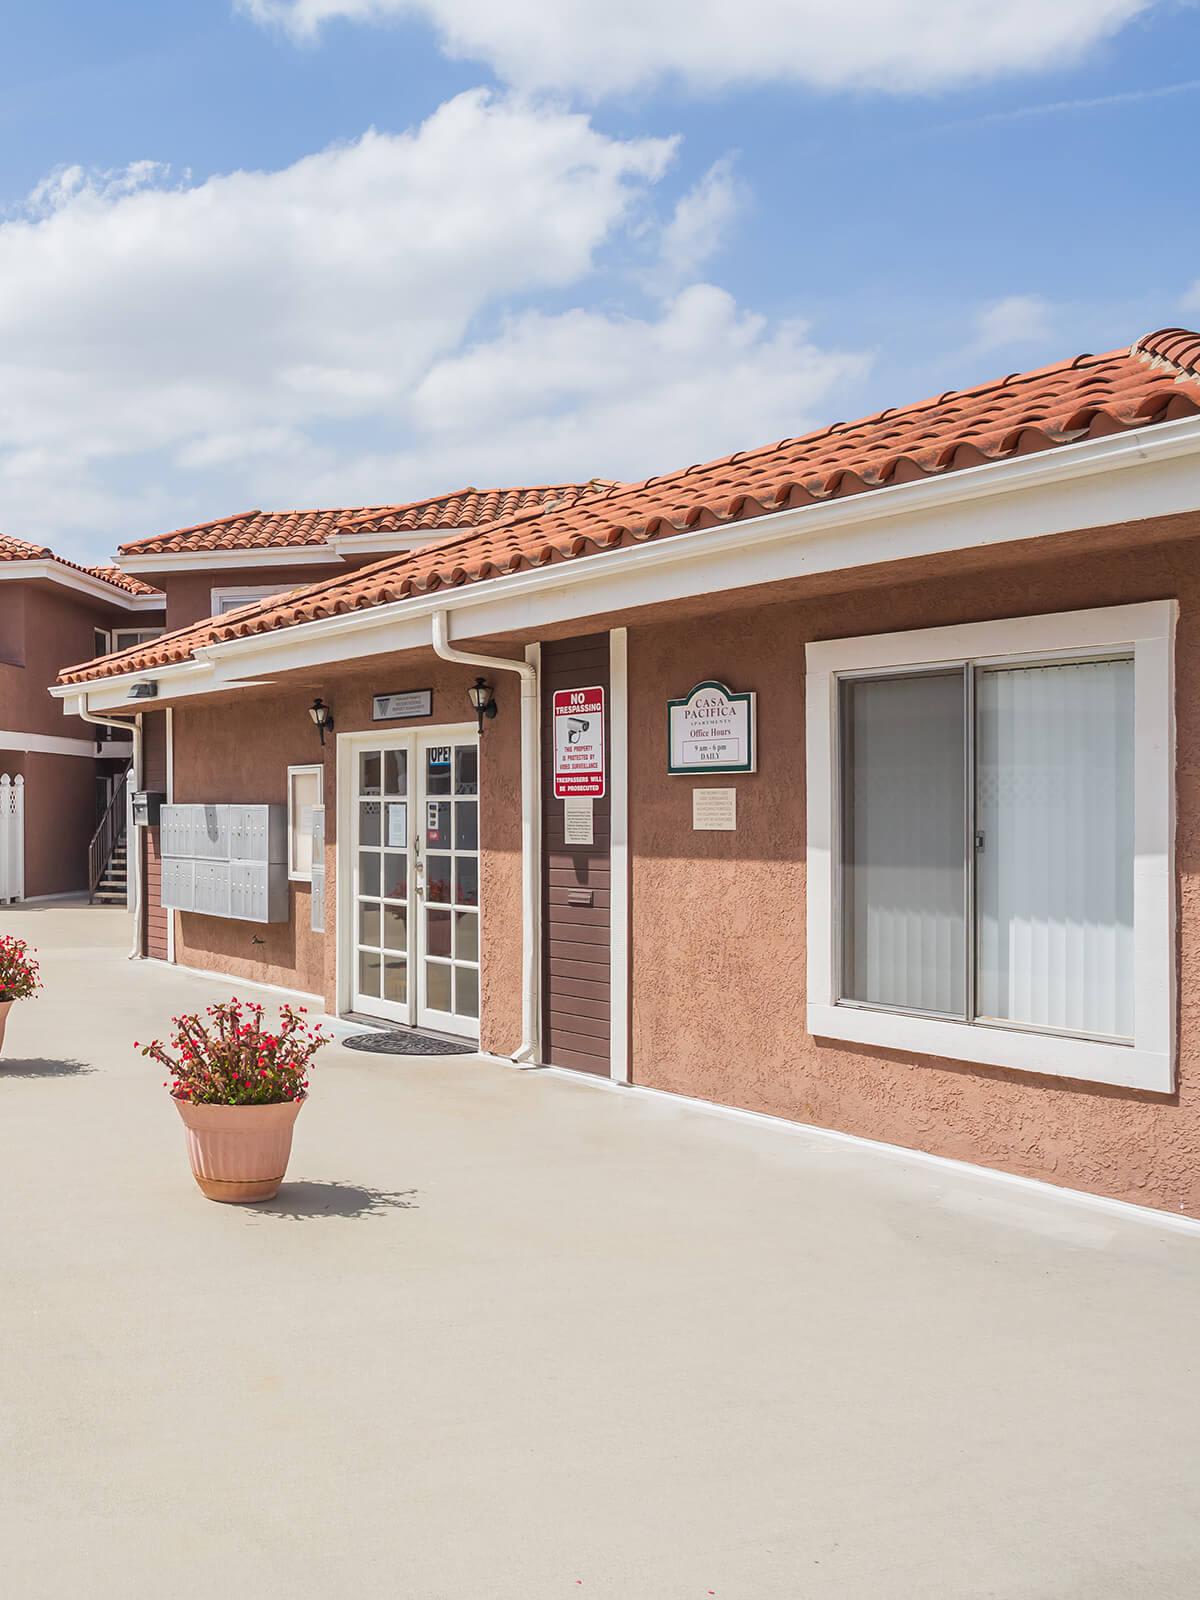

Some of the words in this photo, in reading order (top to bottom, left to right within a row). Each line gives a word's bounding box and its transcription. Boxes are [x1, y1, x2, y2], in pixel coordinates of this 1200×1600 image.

[570, 693, 585, 704] NO
[695, 698, 725, 708] CASA
[556, 703, 601, 715] TRESPASSING
[684, 707, 737, 719] PACIFICA
[690, 729, 709, 737] Office
[711, 728, 731, 737] Hours
[717, 744, 727, 752] pm
[431, 746, 451, 762] OPE
[568, 784, 599, 792] PROSECUTED
